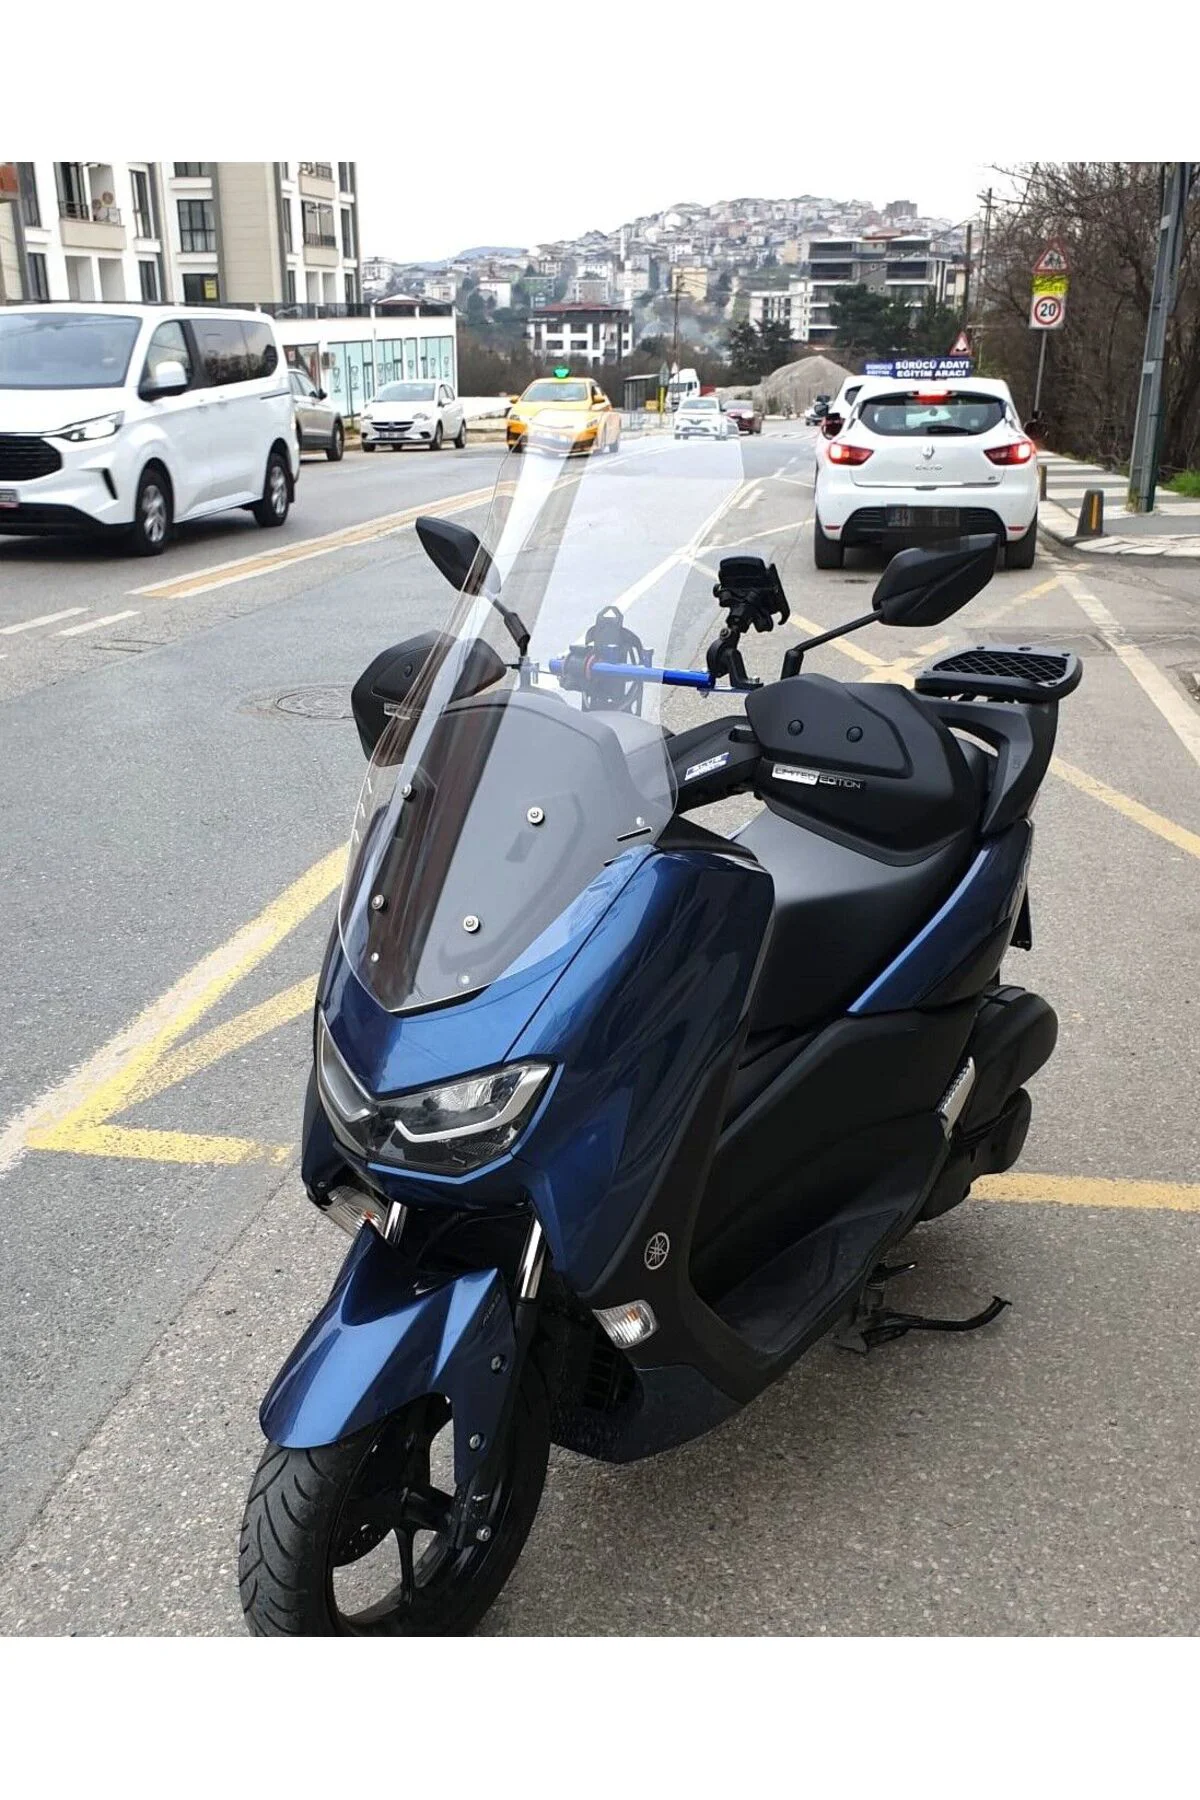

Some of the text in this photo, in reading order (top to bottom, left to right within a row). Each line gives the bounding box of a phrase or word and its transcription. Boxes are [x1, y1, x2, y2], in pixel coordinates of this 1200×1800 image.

[1040, 303, 1057, 317] 20
[895, 360, 970, 370] SÜRÜCÜ ADAYI
[819, 775, 861, 789] EDITION
